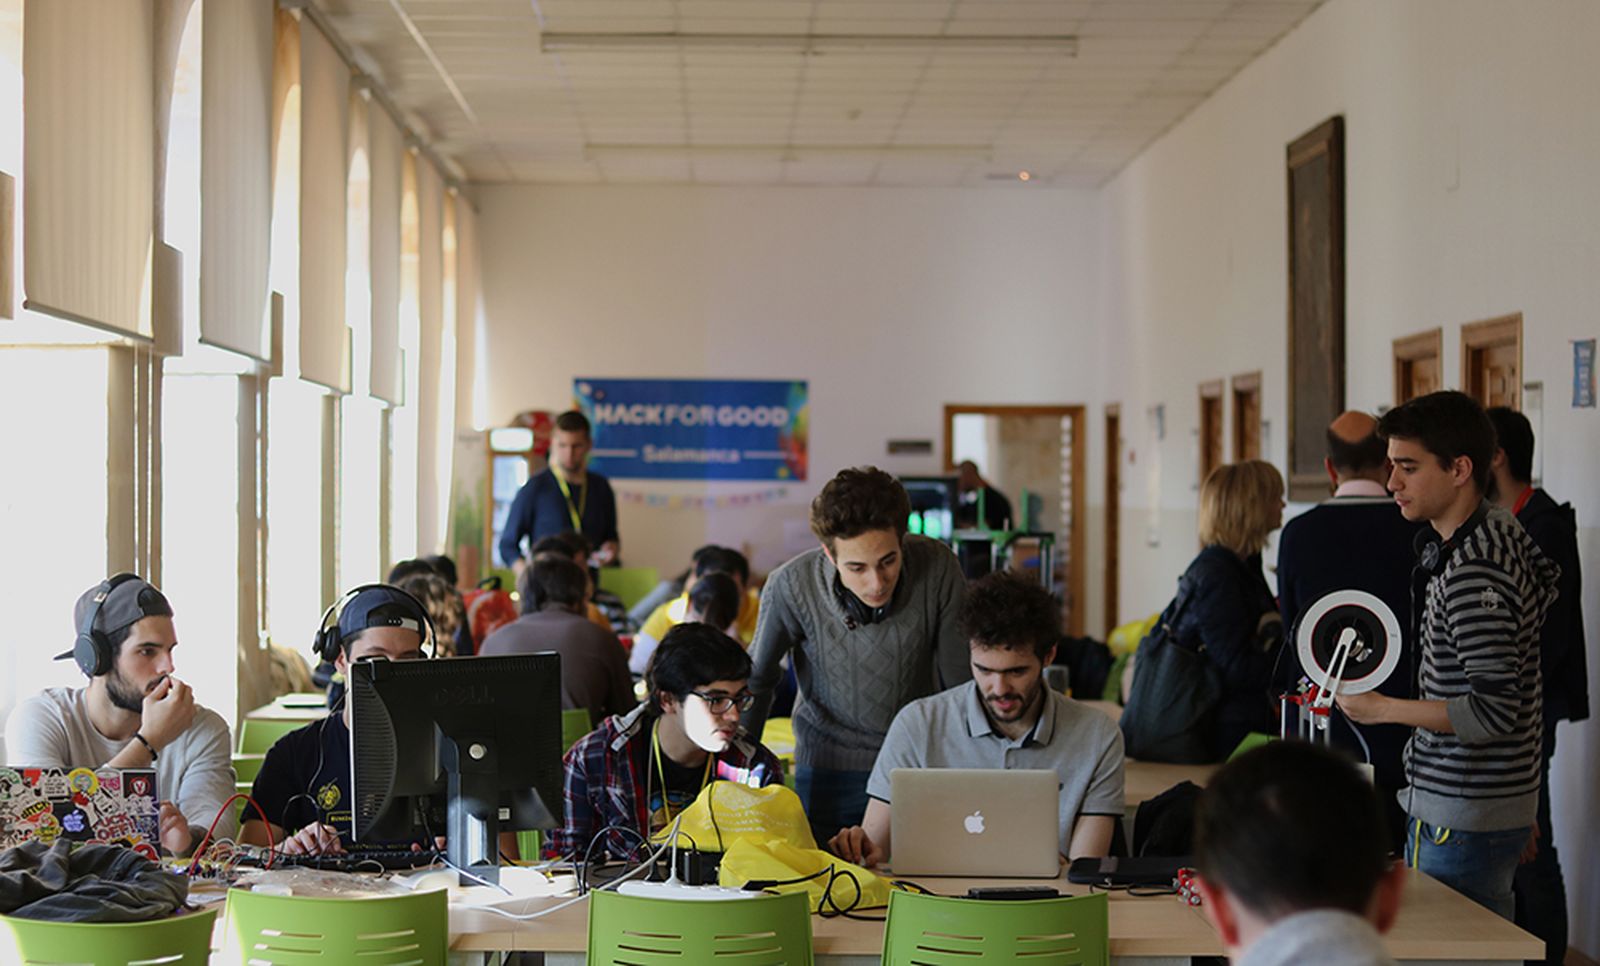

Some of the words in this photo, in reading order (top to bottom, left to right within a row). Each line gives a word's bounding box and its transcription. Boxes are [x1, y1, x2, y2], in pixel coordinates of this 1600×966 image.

[594, 404, 664, 426] HACK
[666, 405, 716, 427] FOR
[717, 406, 788, 427] GOOD
[643, 444, 740, 463] Salamanca
